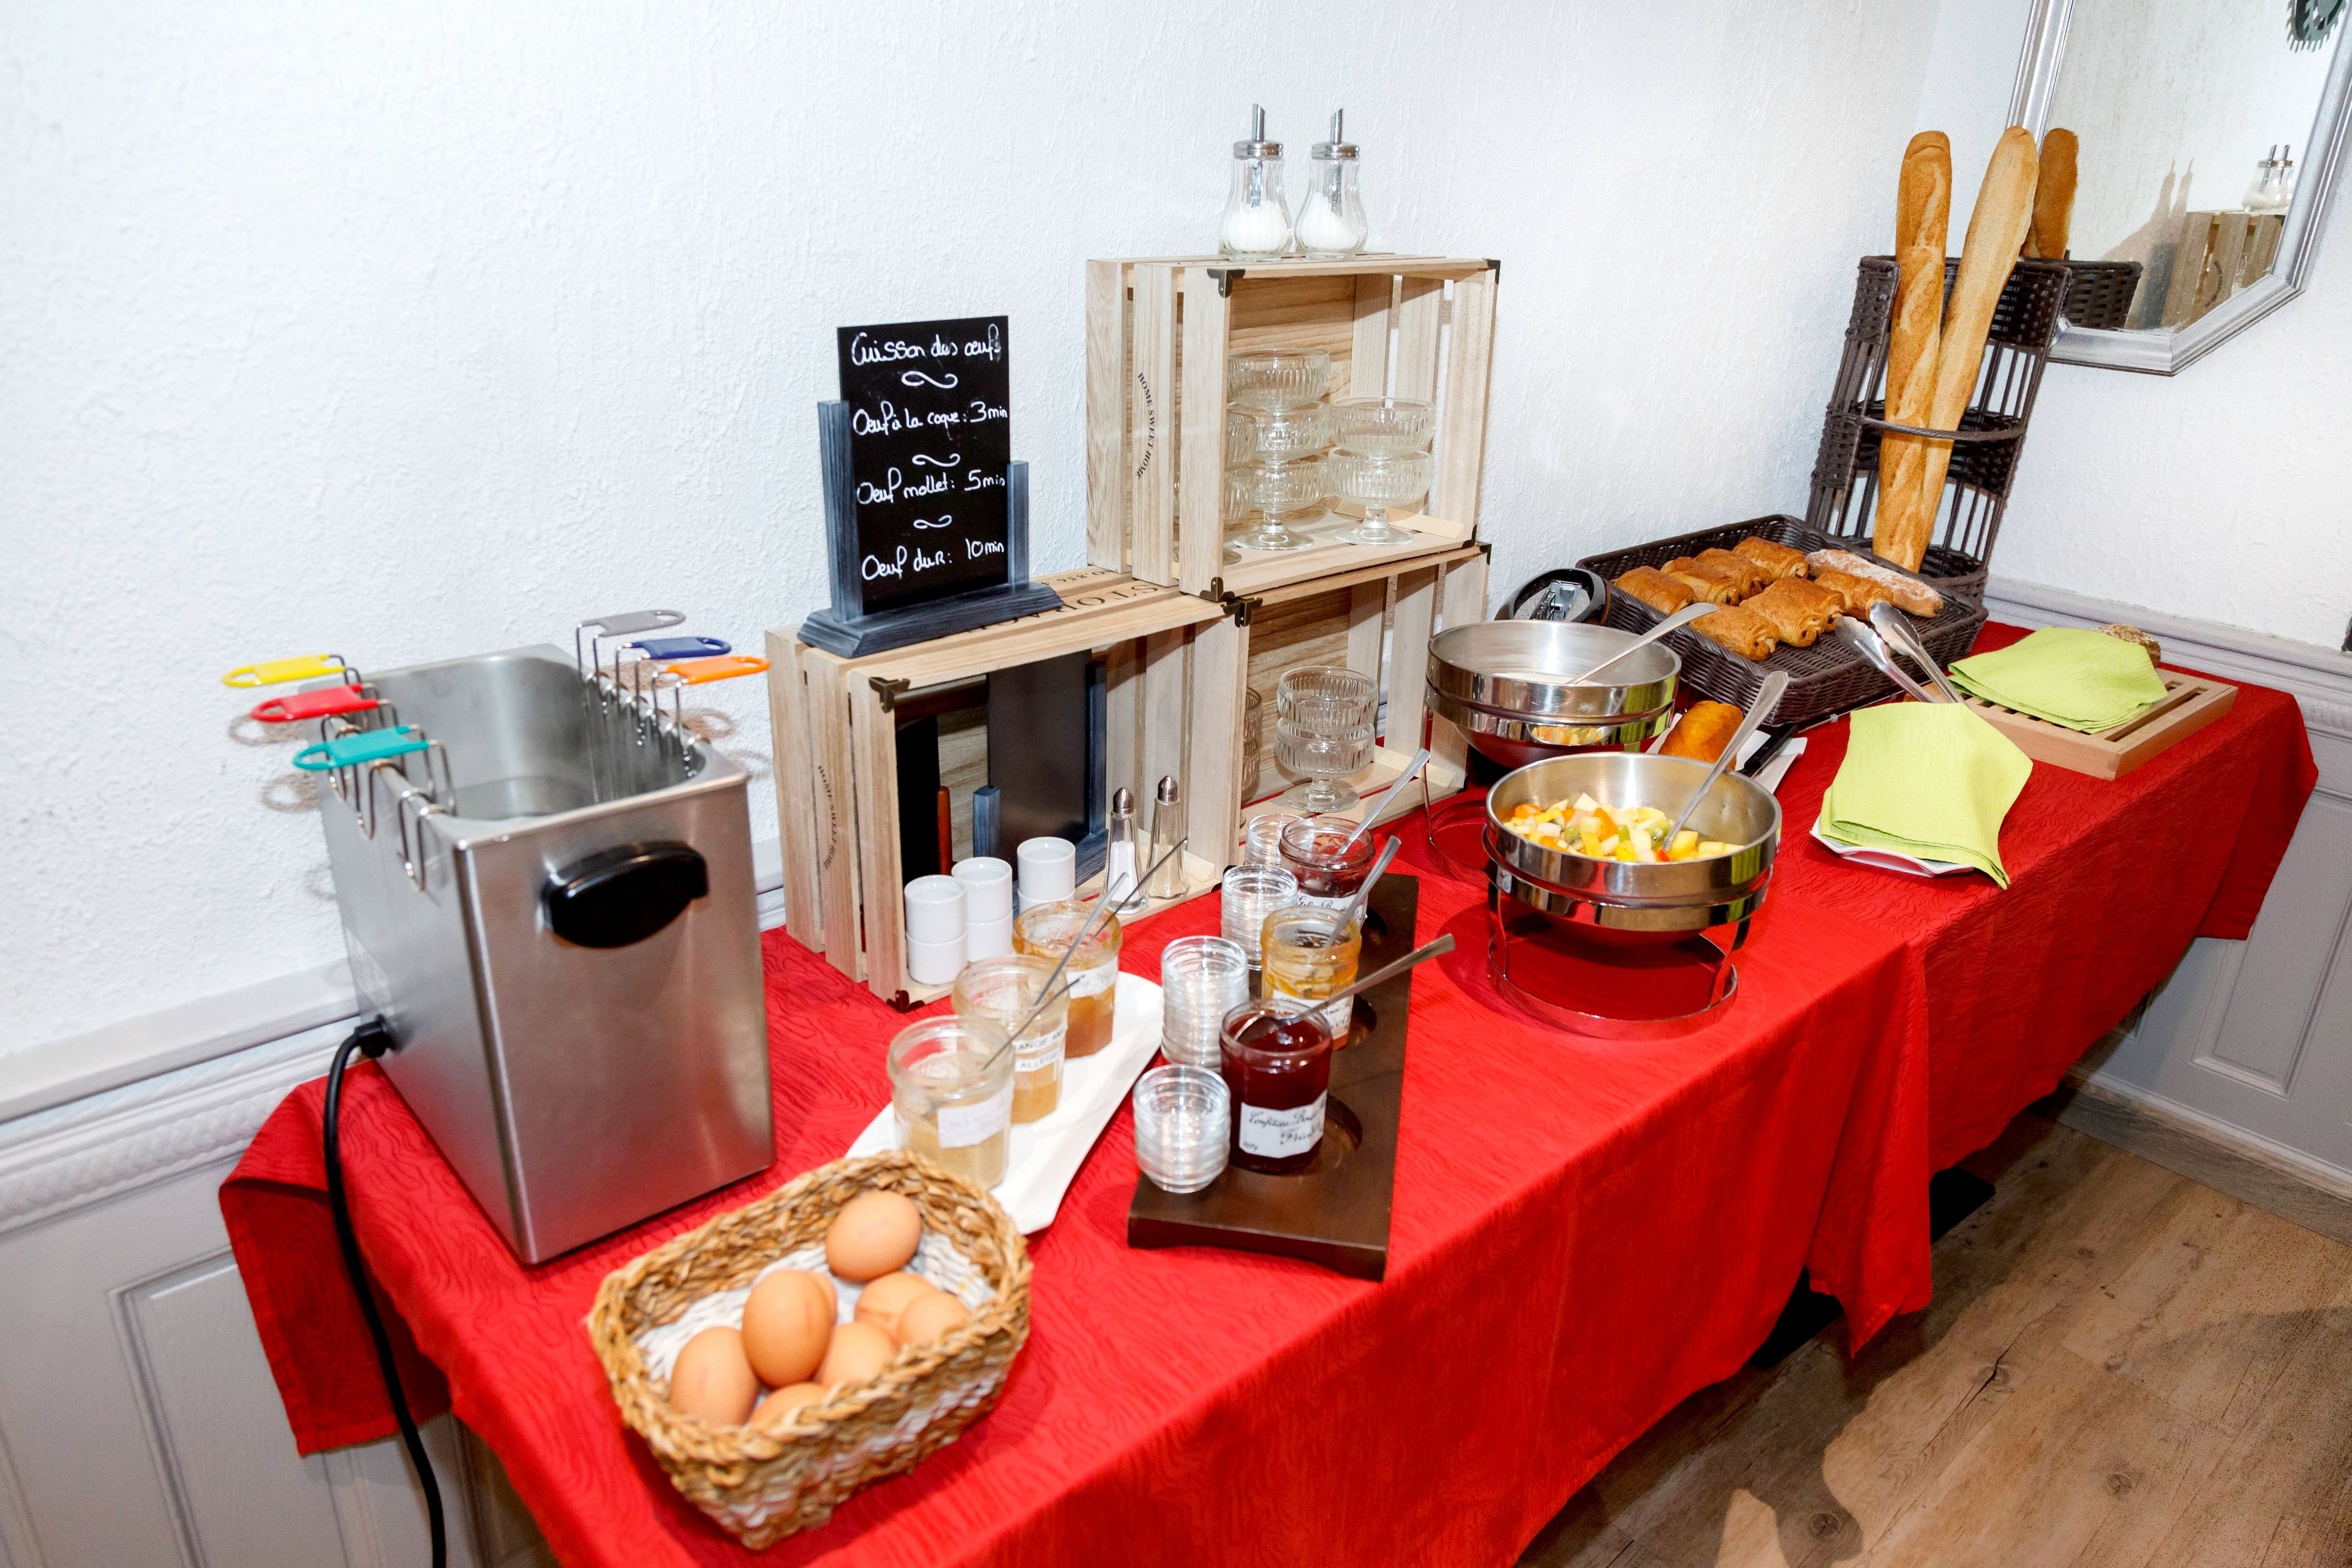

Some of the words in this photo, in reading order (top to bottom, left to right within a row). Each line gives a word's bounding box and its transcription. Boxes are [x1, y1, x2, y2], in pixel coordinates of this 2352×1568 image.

[851, 331, 927, 366] Cuisson
[1137, 372, 1153, 407] HOME
[904, 408, 923, 428] la
[1135, 450, 1152, 480] HOME
[857, 467, 902, 504] Oeuf
[861, 545, 908, 580] Oeuf
